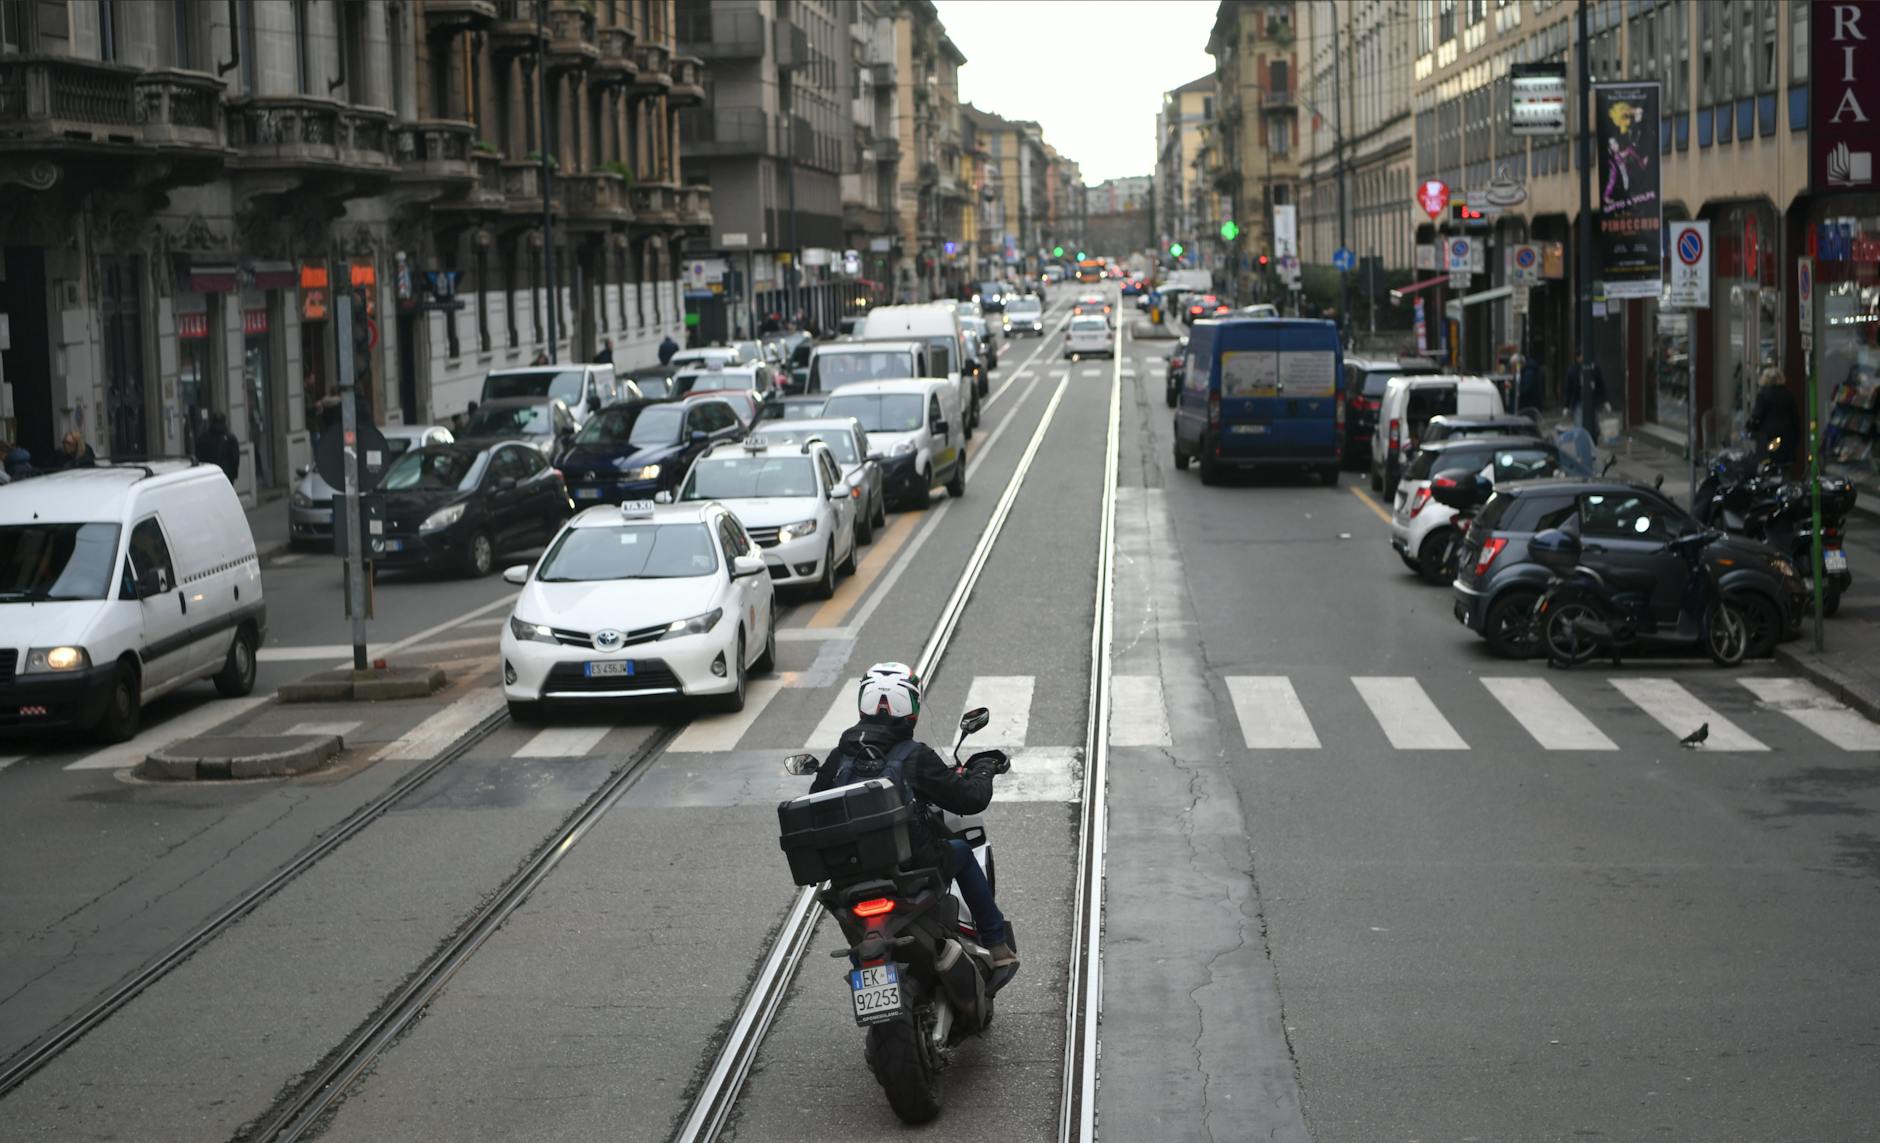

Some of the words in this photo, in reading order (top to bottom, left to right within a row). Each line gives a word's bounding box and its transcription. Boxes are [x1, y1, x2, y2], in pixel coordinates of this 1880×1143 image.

[1601, 217, 1660, 233] PINOCCHIO
[624, 501, 653, 512] TAXI
[862, 968, 880, 987] EK
[856, 987, 899, 1011] 92253
